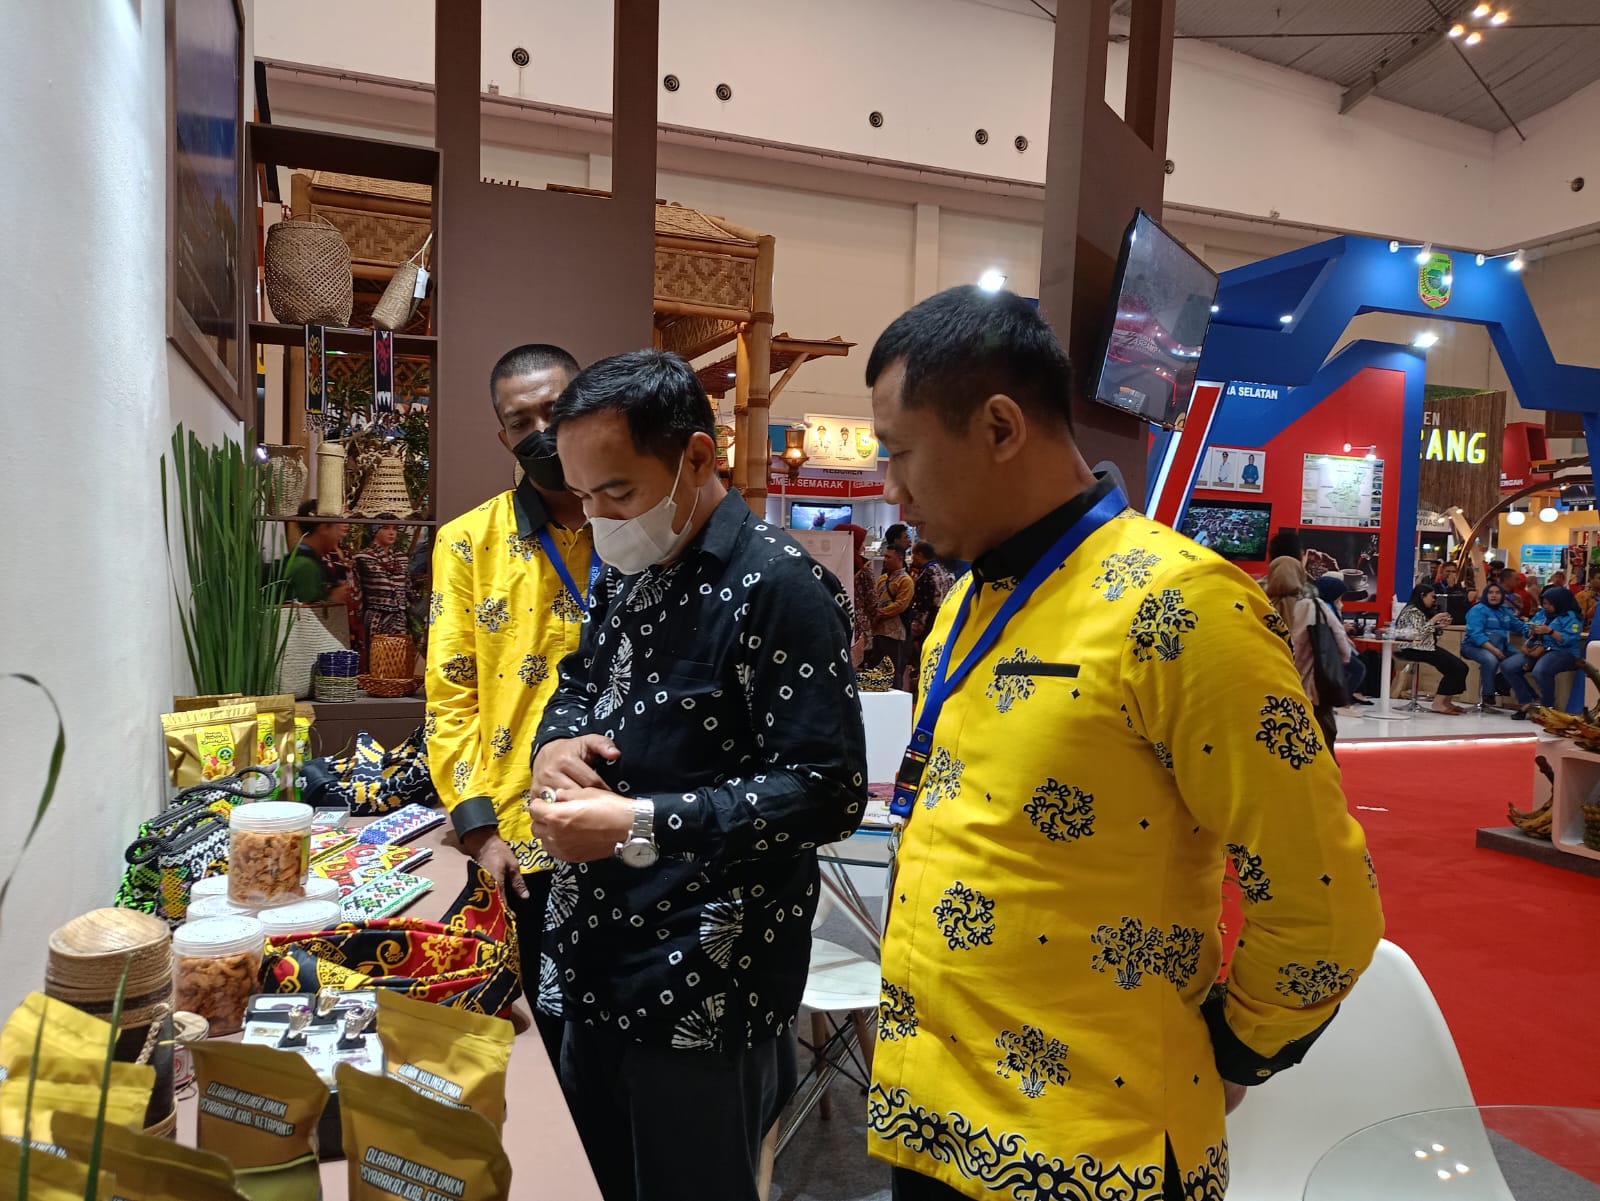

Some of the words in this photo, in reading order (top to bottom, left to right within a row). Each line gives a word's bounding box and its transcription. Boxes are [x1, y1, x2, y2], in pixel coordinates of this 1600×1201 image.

[1238, 386, 1278, 400] SELATAN
[1420, 428, 1487, 464] ANG
[797, 478, 844, 489] SEMARAK
[206, 1081, 238, 1102] OLAHAN
[234, 1090, 266, 1110] KULINER
[262, 1098, 288, 1118] UMKM
[254, 1113, 294, 1136] KETAPANG
[365, 1146, 404, 1172] OLAHAN
[401, 1160, 439, 1186] KULINER
[435, 1173, 465, 1196] UMKM
